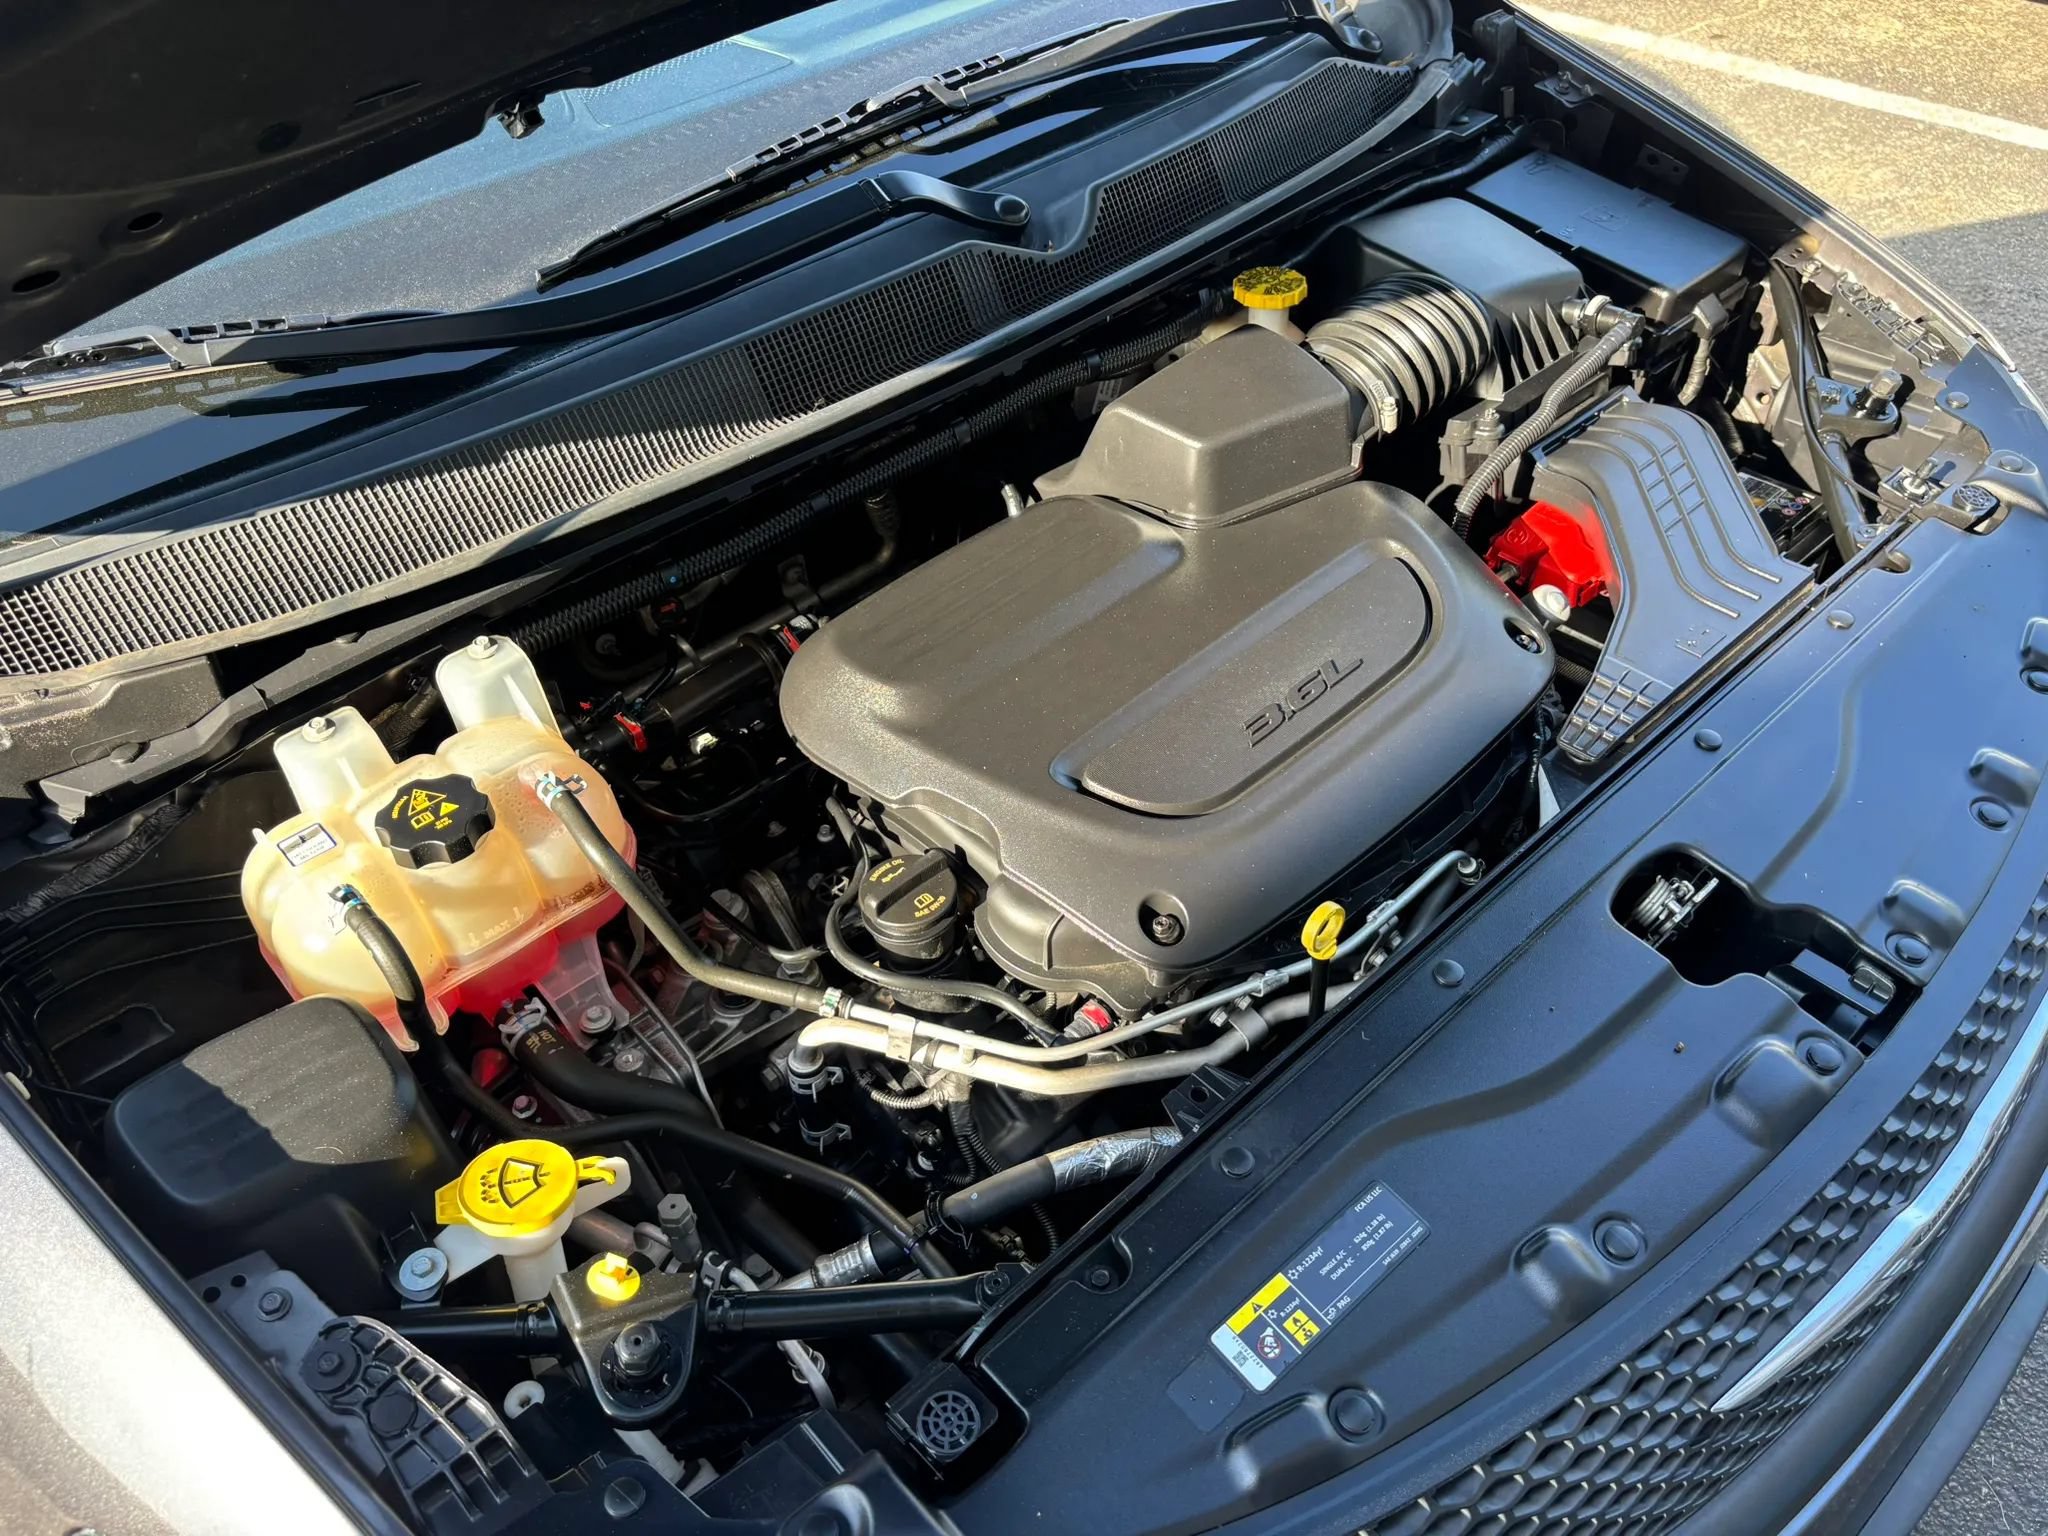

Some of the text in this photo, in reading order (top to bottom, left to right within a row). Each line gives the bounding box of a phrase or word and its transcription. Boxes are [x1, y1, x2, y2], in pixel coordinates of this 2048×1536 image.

[1242, 658, 1364, 748] 3.6L
[869, 858, 905, 882] ENGINE OIL
[914, 907, 931, 918] SAE
[483, 919, 511, 939] MAX
[1354, 1186, 1383, 1212] FCA US LLC
[1296, 1245, 1324, 1272] R-1234yf
[1319, 1258, 1338, 1276] SINGLE
[1335, 1249, 1347, 1261] A/C
[1330, 1266, 1346, 1280] DUAL
[1343, 1256, 1355, 1268] A/C
[1336, 1295, 1351, 1309] PAG
